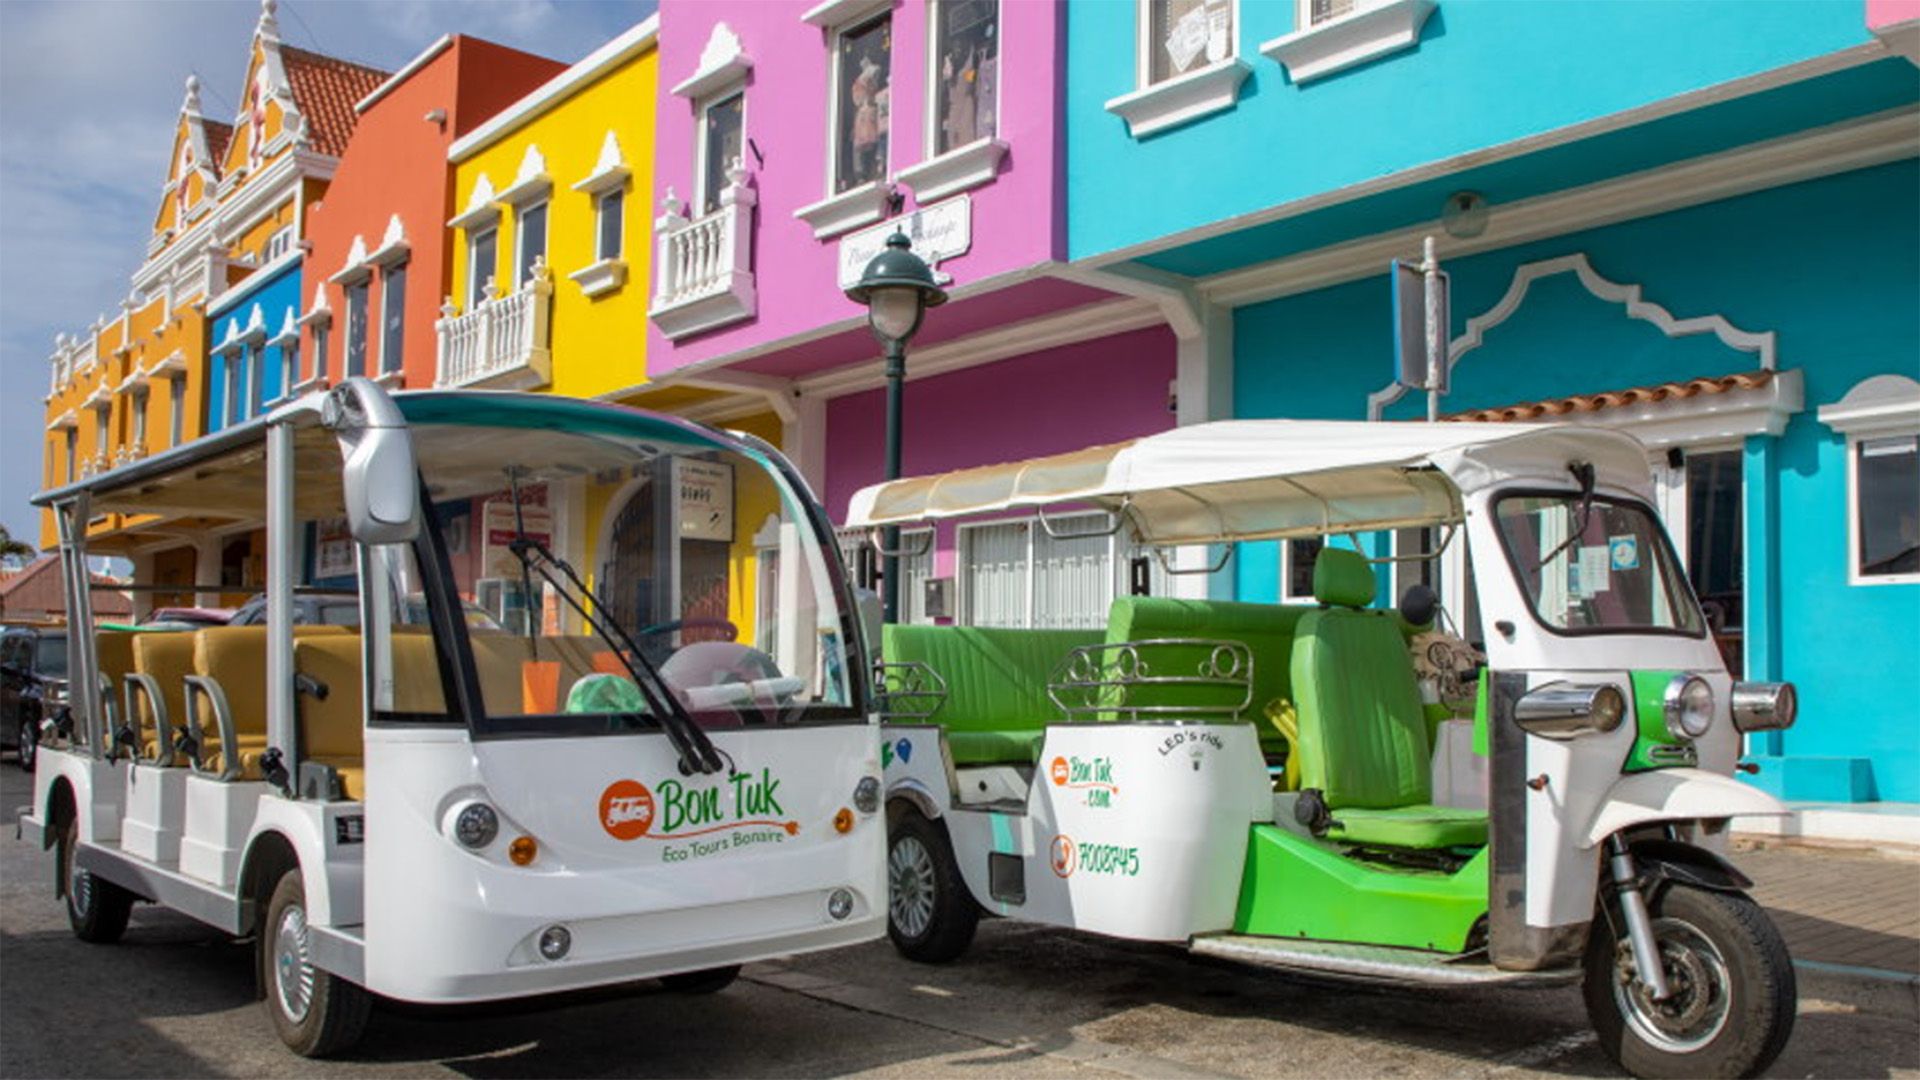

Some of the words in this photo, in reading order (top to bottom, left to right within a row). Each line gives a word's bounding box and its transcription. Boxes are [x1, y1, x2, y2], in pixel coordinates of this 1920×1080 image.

[1158, 730, 1197, 756] LED's
[1200, 731, 1224, 751] ride
[1069, 756, 1092, 783] Bon
[1093, 756, 1114, 784] Tuk
[656, 779, 724, 833] Bon
[728, 768, 784, 820] Tuk
[662, 845, 689, 863] Eco
[689, 838, 730, 858] Tours
[732, 830, 785, 848] Bonaire
